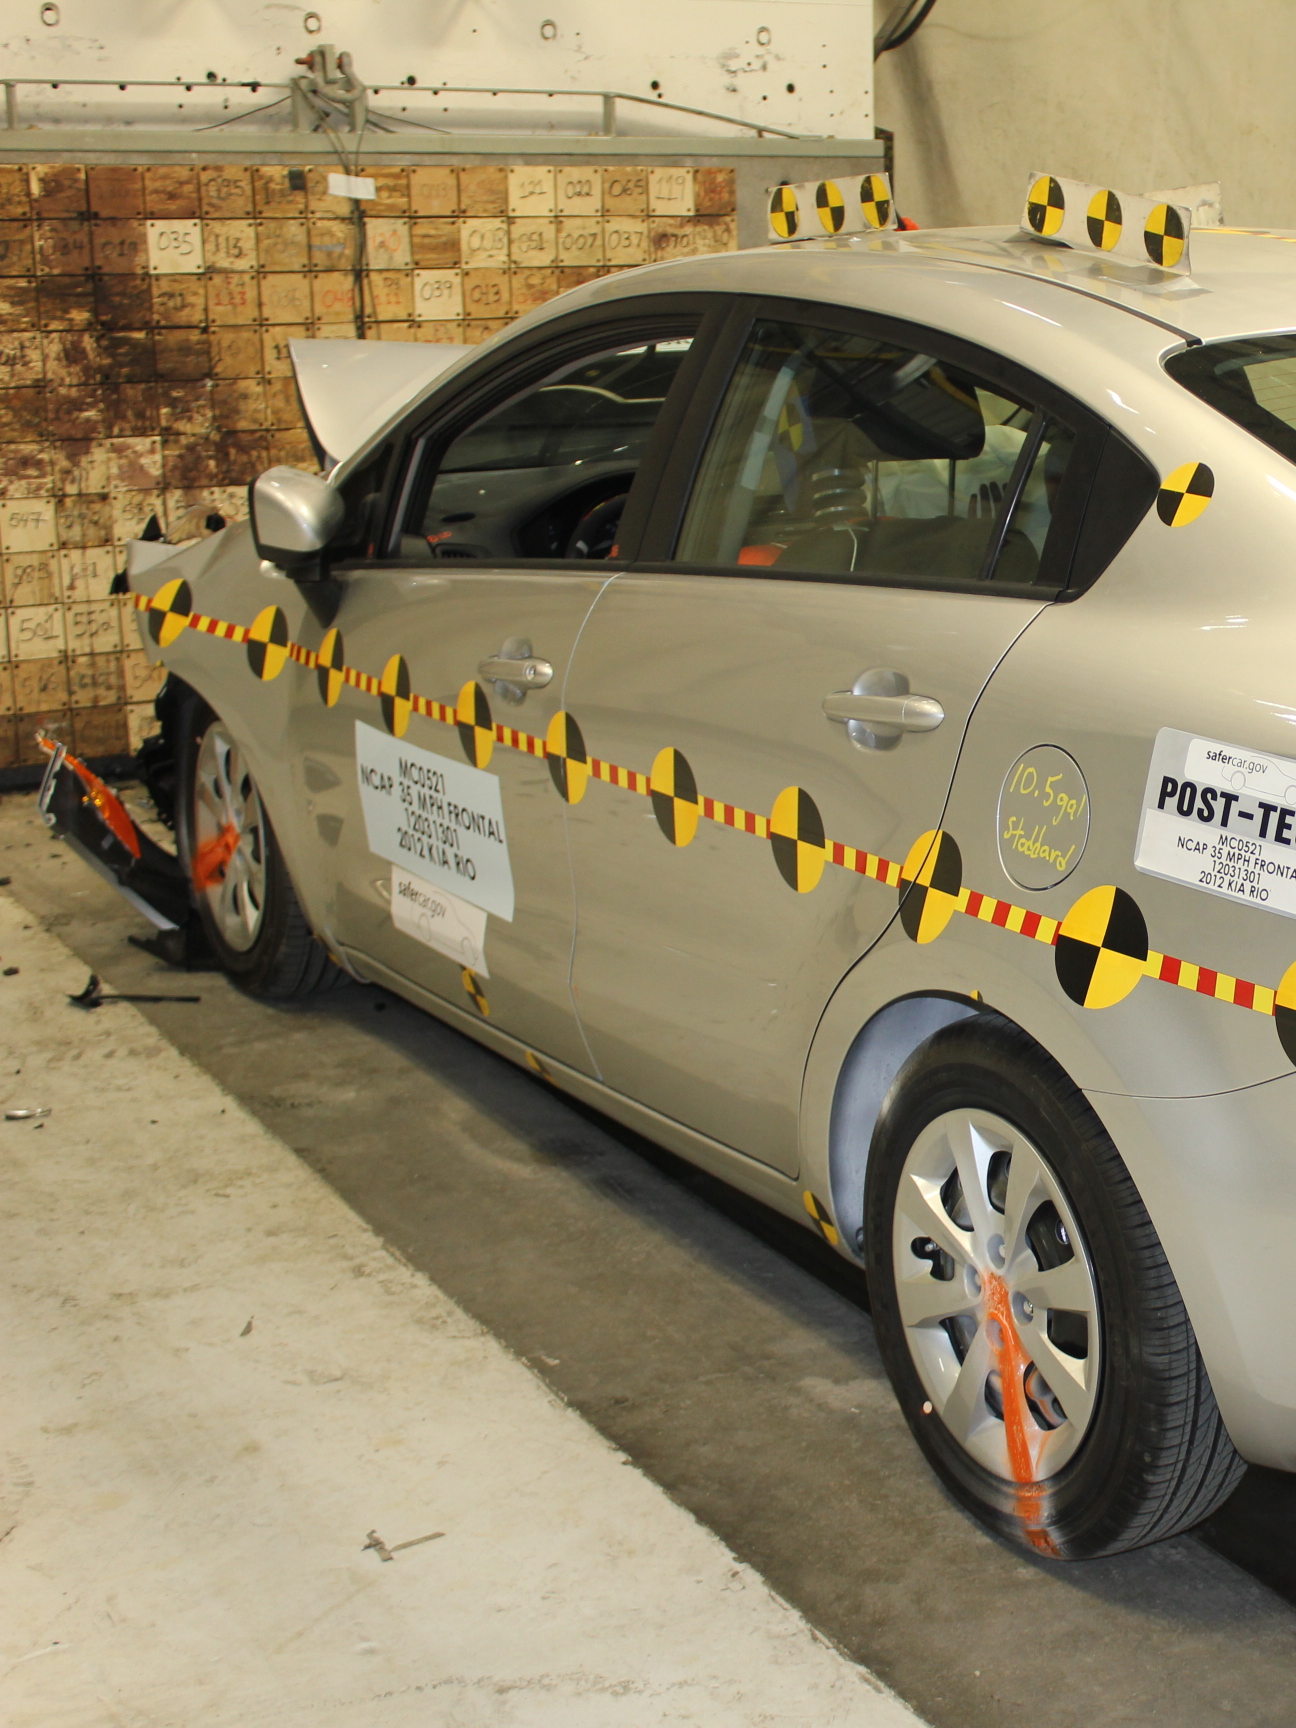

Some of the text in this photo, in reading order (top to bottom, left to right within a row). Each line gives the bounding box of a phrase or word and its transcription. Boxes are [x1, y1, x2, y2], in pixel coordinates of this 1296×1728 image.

[564, 179, 593, 199] 022
[608, 178, 645, 197] 065
[655, 174, 686, 200] 119
[157, 230, 195, 256] 035
[561, 231, 597, 250] 007
[607, 229, 643, 250] 037
[419, 280, 453, 301] 039
[9, 511, 48, 529] 547
[20, 613, 59, 642] 501
[1206, 749, 1268, 774] safercar.gov
[398, 757, 446, 796] MC0521
[360, 764, 504, 844] NCAP 35 MPH FRONTAL
[404, 808, 460, 850] 12031301
[397, 828, 476, 881] 2012 KIA RIO
[1177, 835, 1208, 855] NCAP
[1210, 846, 1223, 860] 35
[1225, 850, 1250, 868] MPH
[1217, 834, 1262, 857] MC0521
[1212, 860, 1261, 885] 12031301
[398, 879, 447, 918] safercar.gov
[1198, 870, 1270, 902] 2012 KIA RIO
